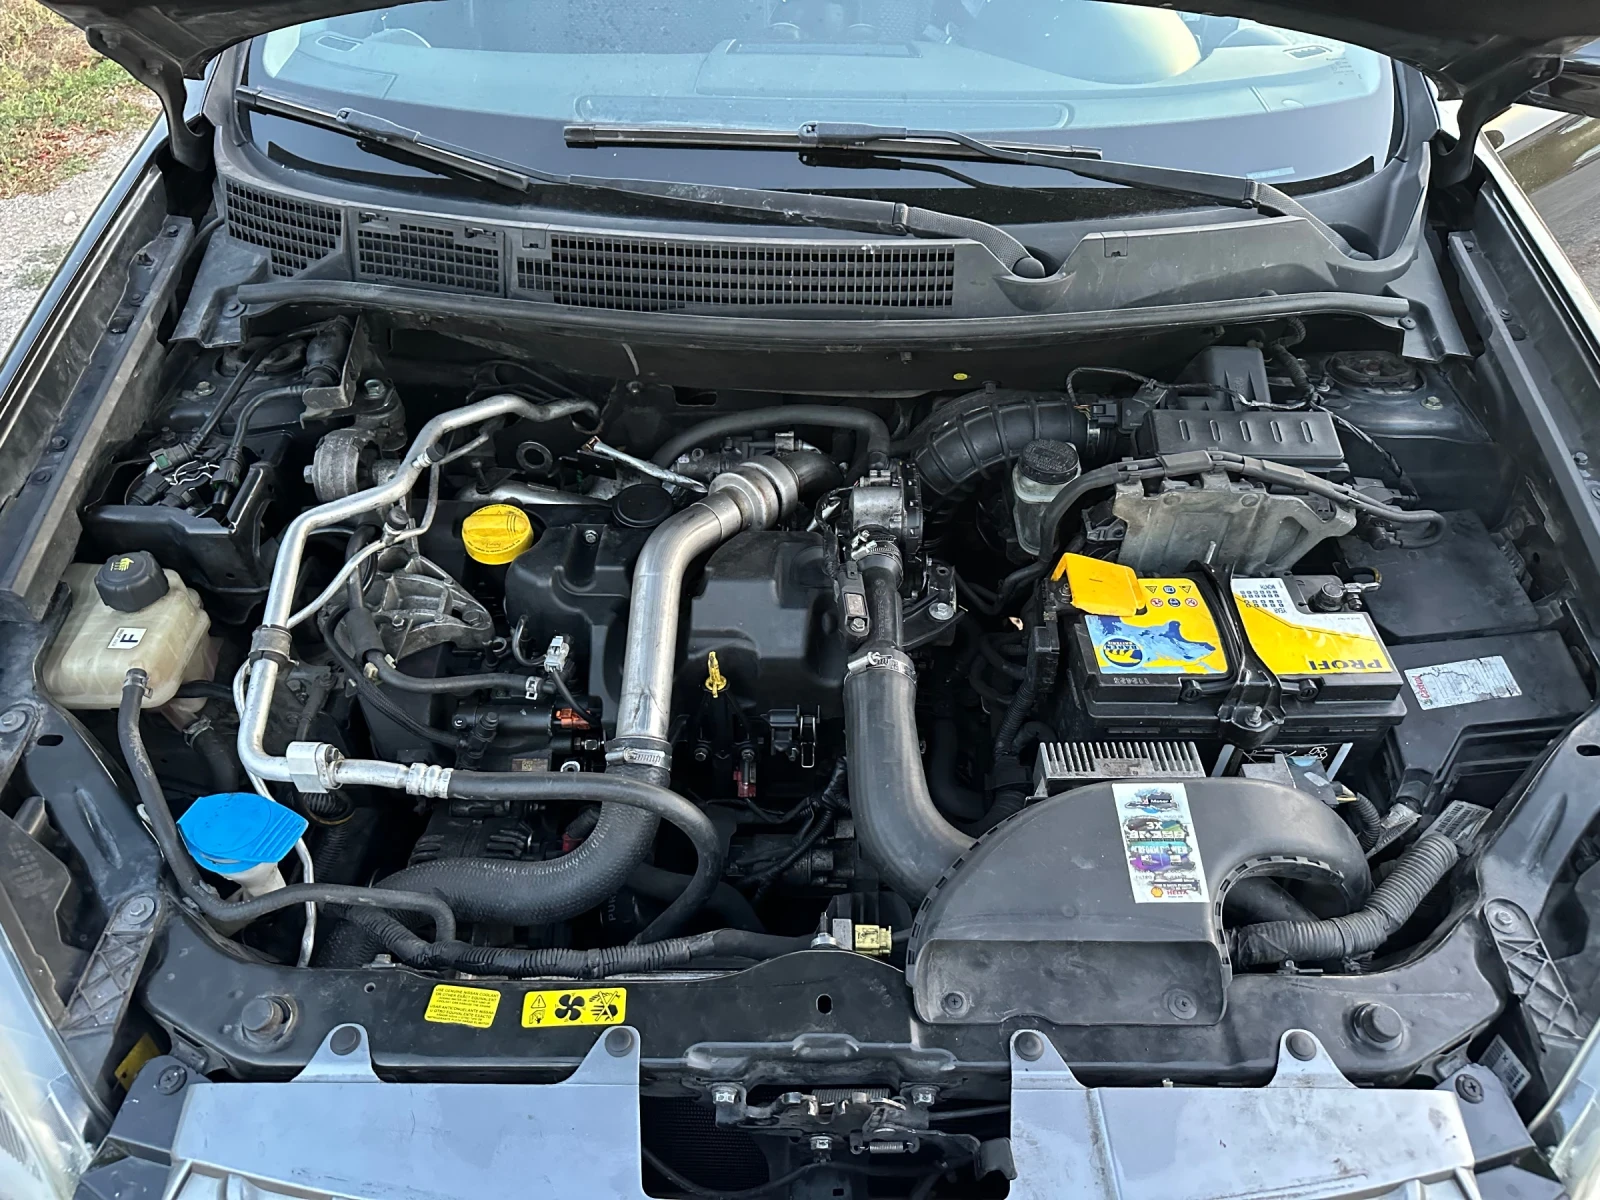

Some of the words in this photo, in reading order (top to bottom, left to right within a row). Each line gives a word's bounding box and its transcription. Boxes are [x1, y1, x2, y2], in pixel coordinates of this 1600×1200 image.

[119, 633, 139, 643] F
[1309, 659, 1382, 670] PROFI
[1145, 821, 1164, 830] 3X
